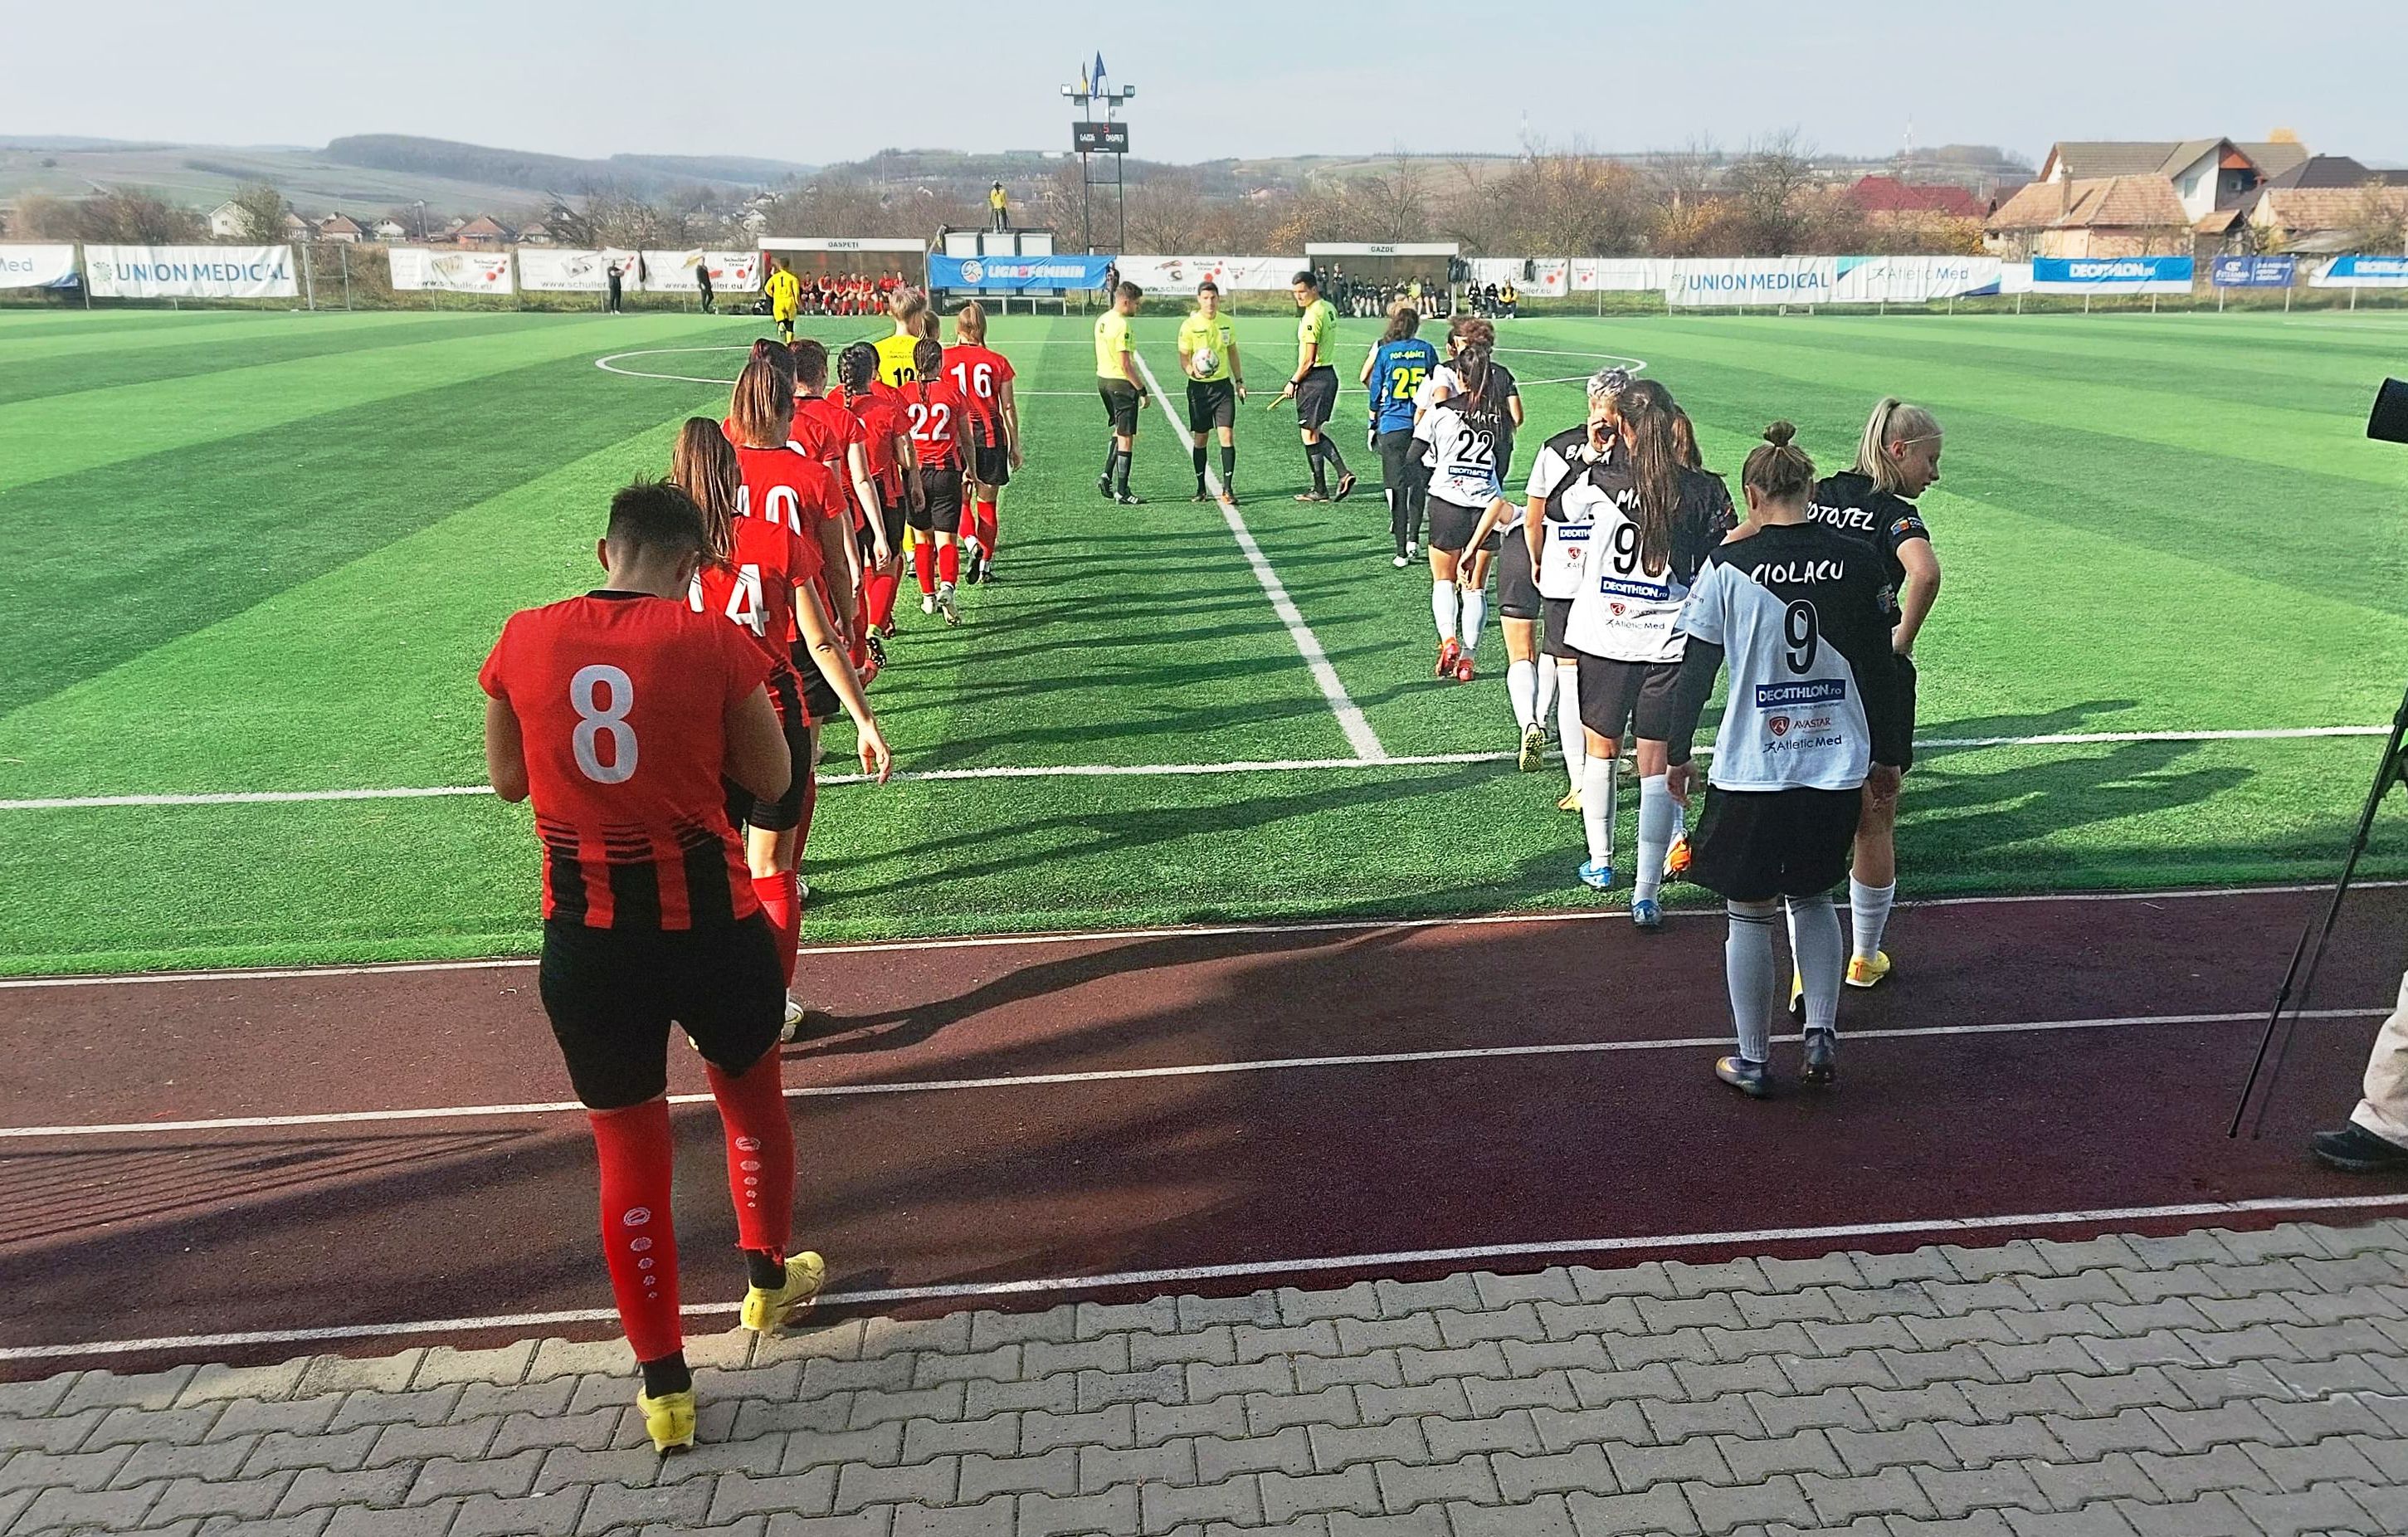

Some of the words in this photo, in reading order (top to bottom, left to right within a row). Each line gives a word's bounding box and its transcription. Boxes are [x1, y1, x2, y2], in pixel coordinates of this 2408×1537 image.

[116, 263, 188, 281] UNION
[193, 263, 290, 281] MEDICAL
[1689, 274, 1747, 290] UNION
[1751, 272, 1829, 290] MEDICAL
[1936, 267, 1969, 280] Med
[950, 362, 992, 398] 16
[1392, 367, 1426, 399] 25
[908, 403, 951, 441] 22
[1456, 429, 1493, 465] 22
[1613, 523, 1641, 574] 9
[1750, 559, 1845, 586] CIOLACU
[1783, 599, 1819, 676] 9
[1758, 684, 1842, 702] DECATHLON.ro
[569, 664, 639, 784] 8
[1793, 717, 1831, 729] AVASTAR
[1815, 734, 1843, 747] Med
